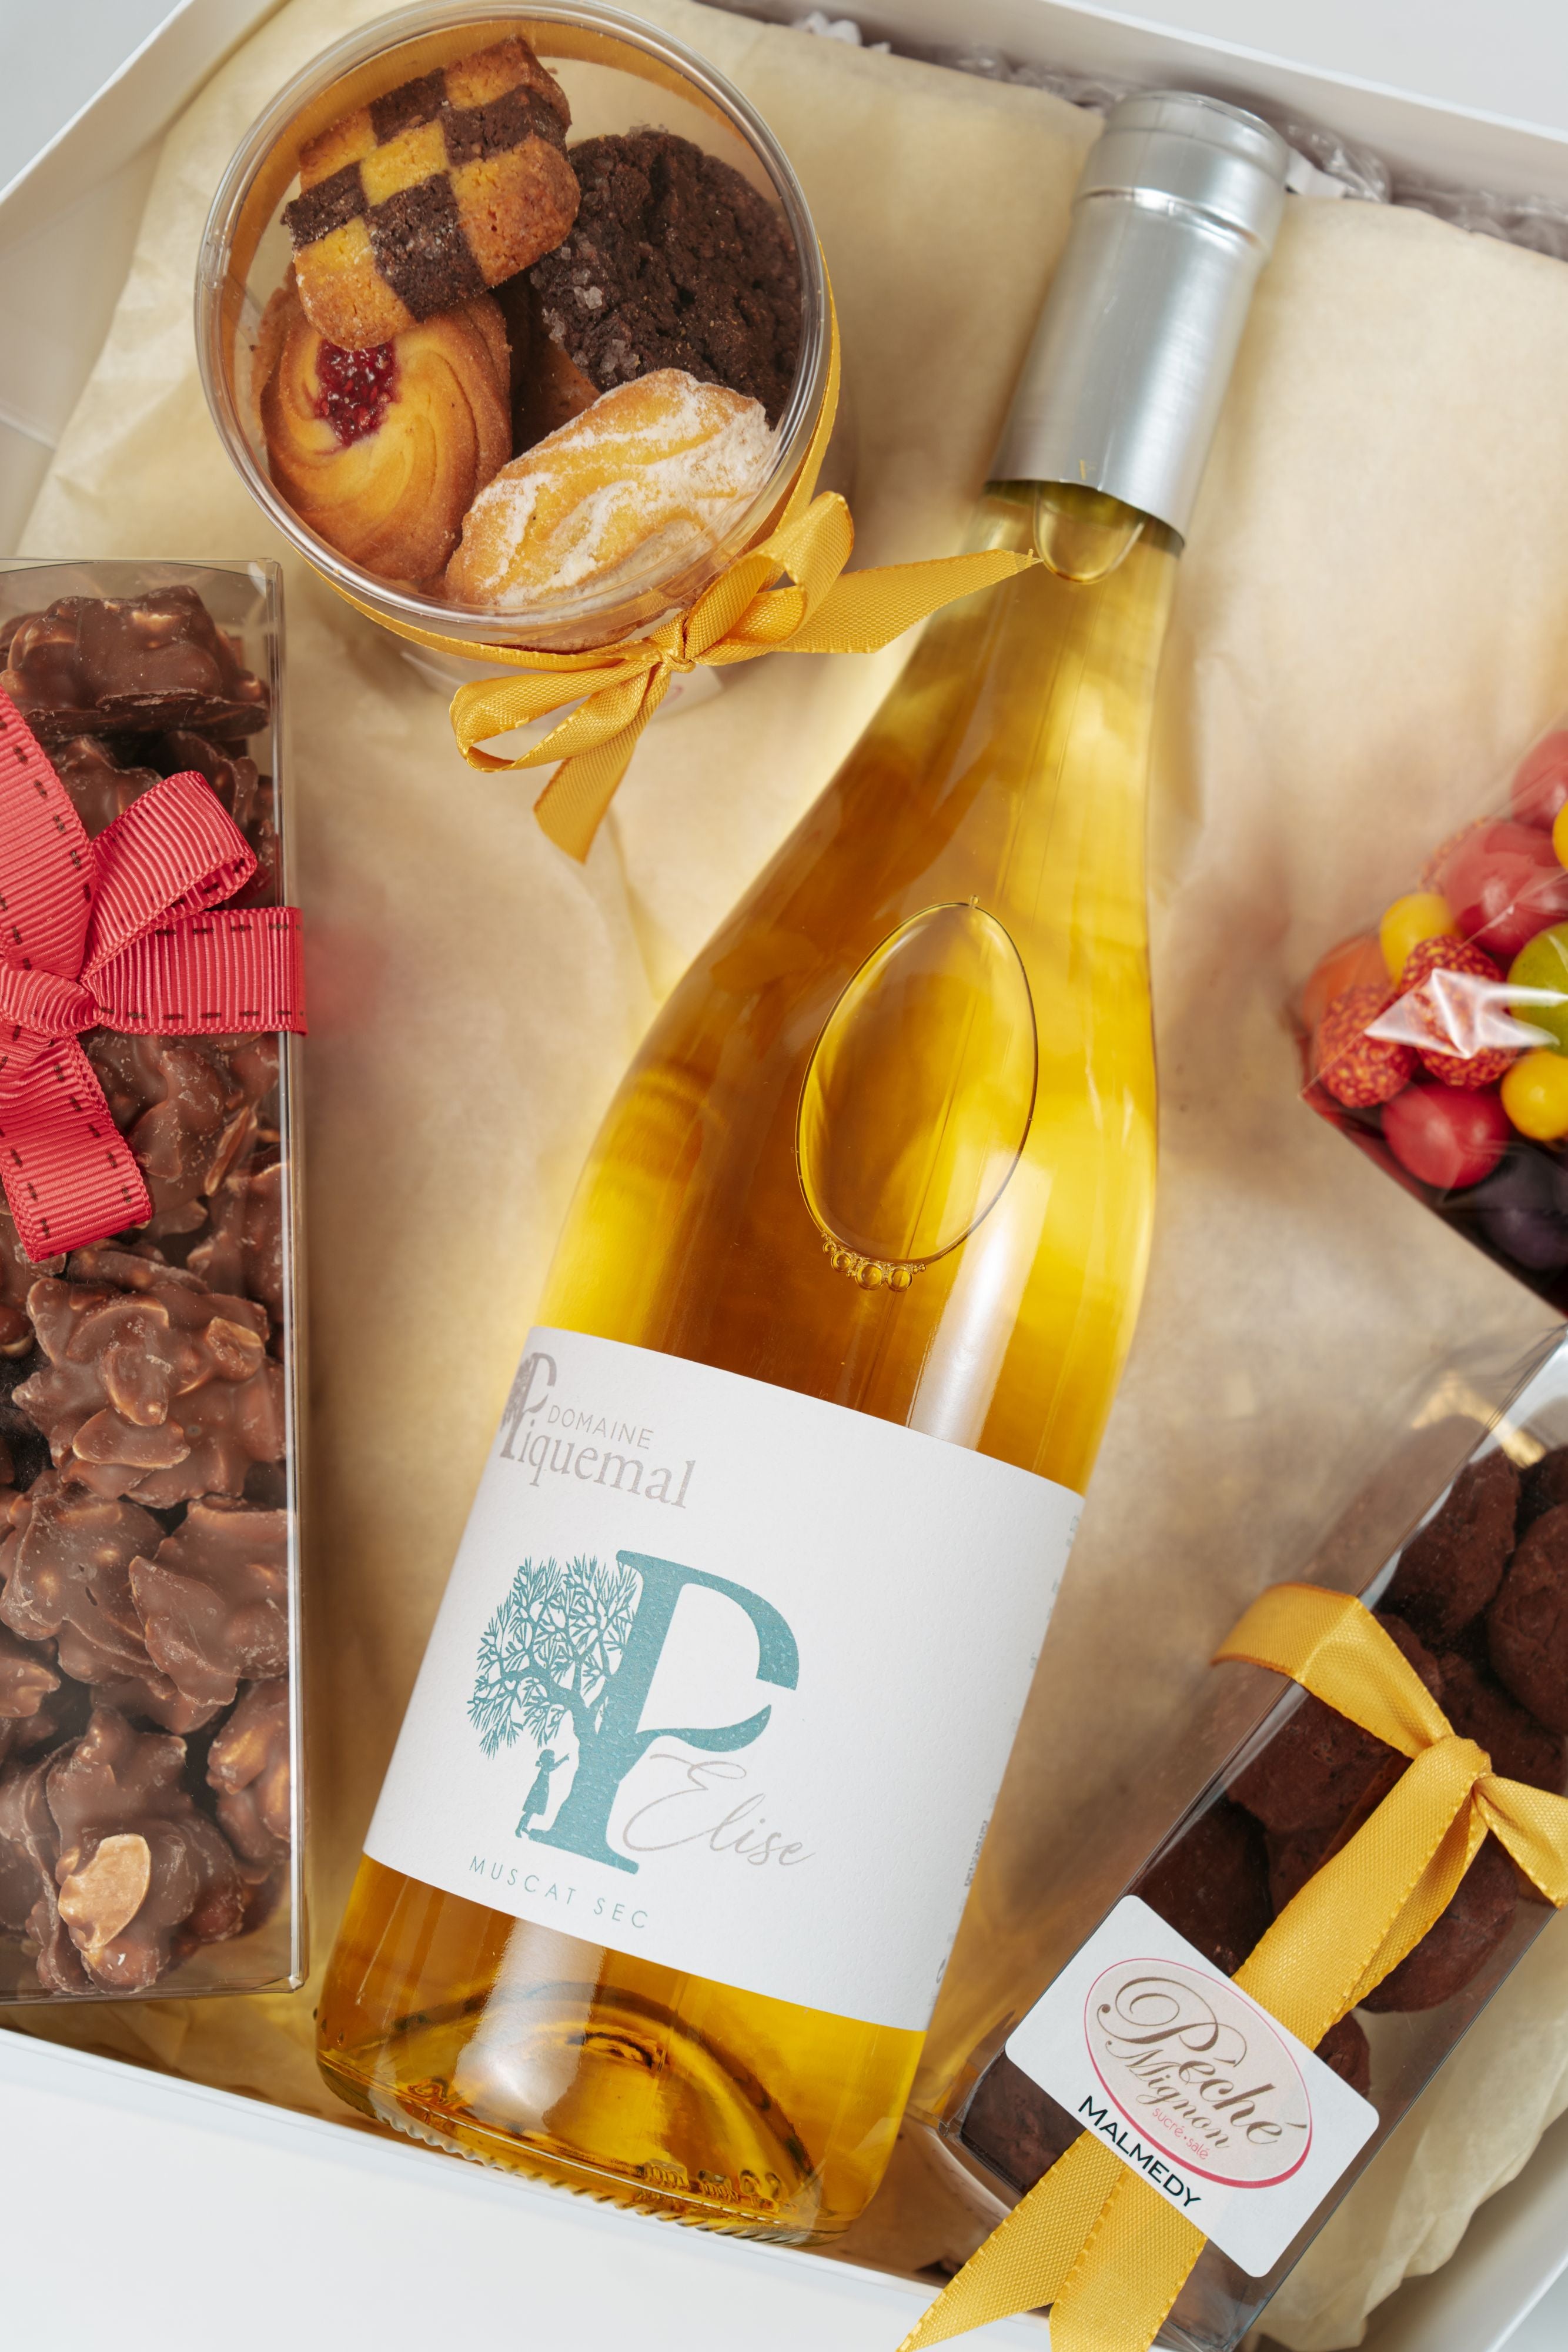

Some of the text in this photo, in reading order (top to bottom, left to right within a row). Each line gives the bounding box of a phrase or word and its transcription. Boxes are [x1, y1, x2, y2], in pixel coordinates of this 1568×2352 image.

[547, 1404, 654, 1449] DOMAINE
[623, 1753, 817, 1866] Elise
[469, 1856, 648, 1930] MUSCAT SEC
[1096, 1976, 1307, 2145] Péché
[1105, 2040, 1231, 2149] Mignon
[1078, 2095, 1201, 2208] MALMEDY
